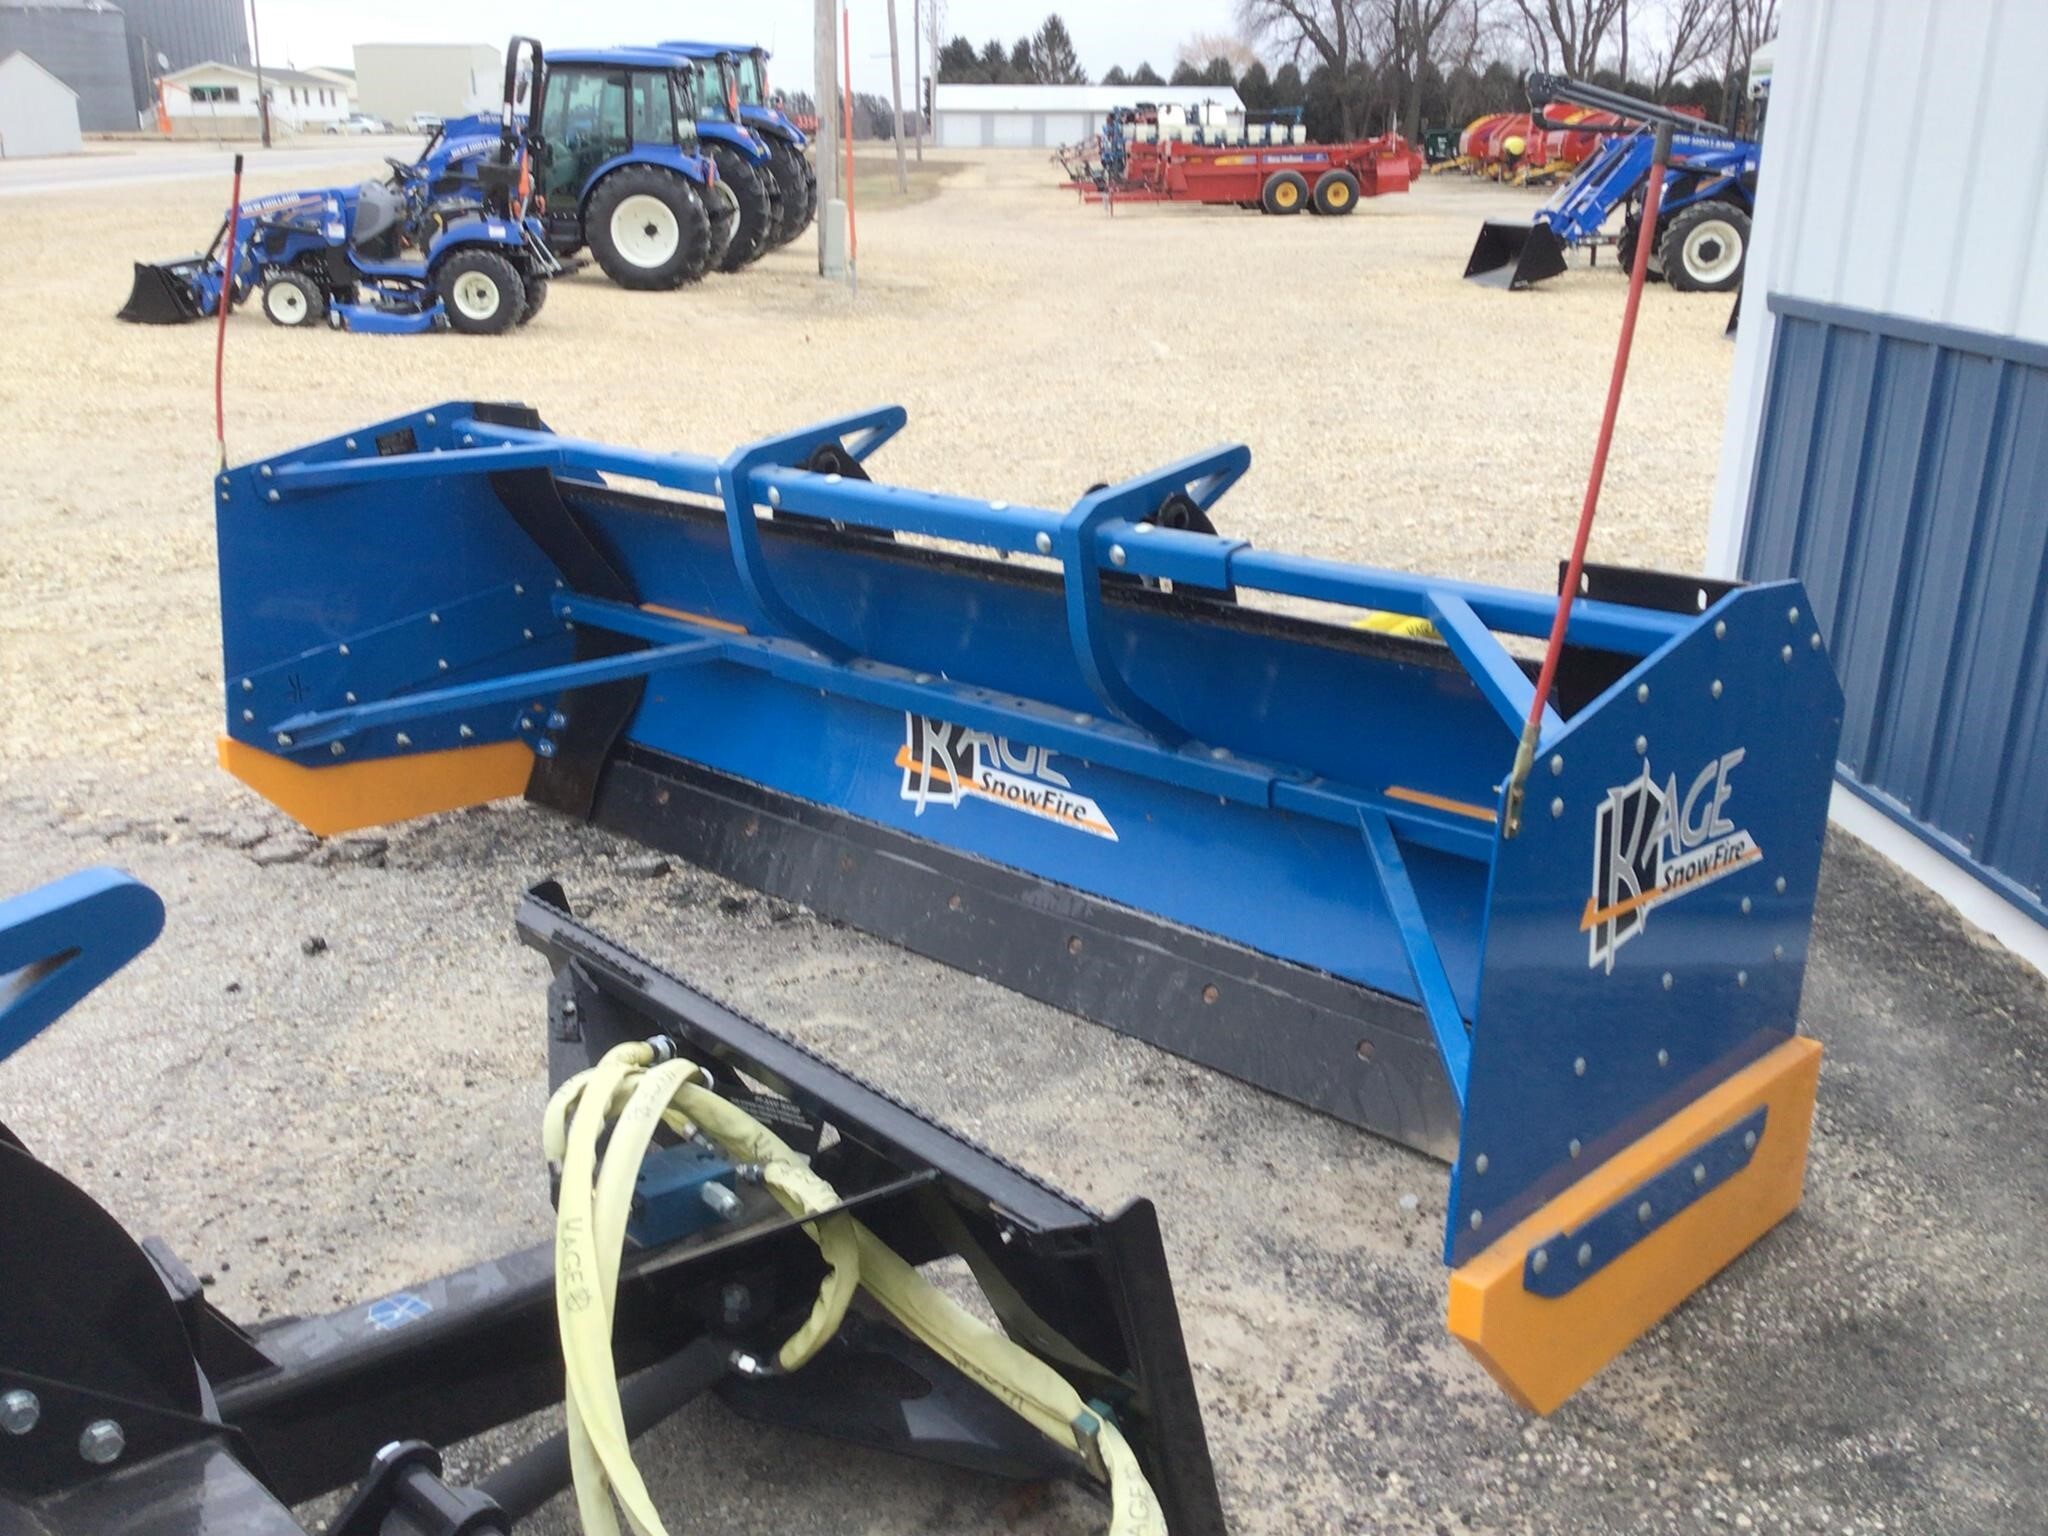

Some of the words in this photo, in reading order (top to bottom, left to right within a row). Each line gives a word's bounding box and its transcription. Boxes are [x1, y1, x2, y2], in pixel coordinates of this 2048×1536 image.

[1691, 136, 1735, 152] HOLLAND
[240, 200, 262, 215] NEW
[261, 191, 301, 208] HOLLAND
[979, 771, 1088, 821] SnowFire
[1603, 746, 1747, 976] KAGE
[1661, 840, 1746, 893] SnowFire
